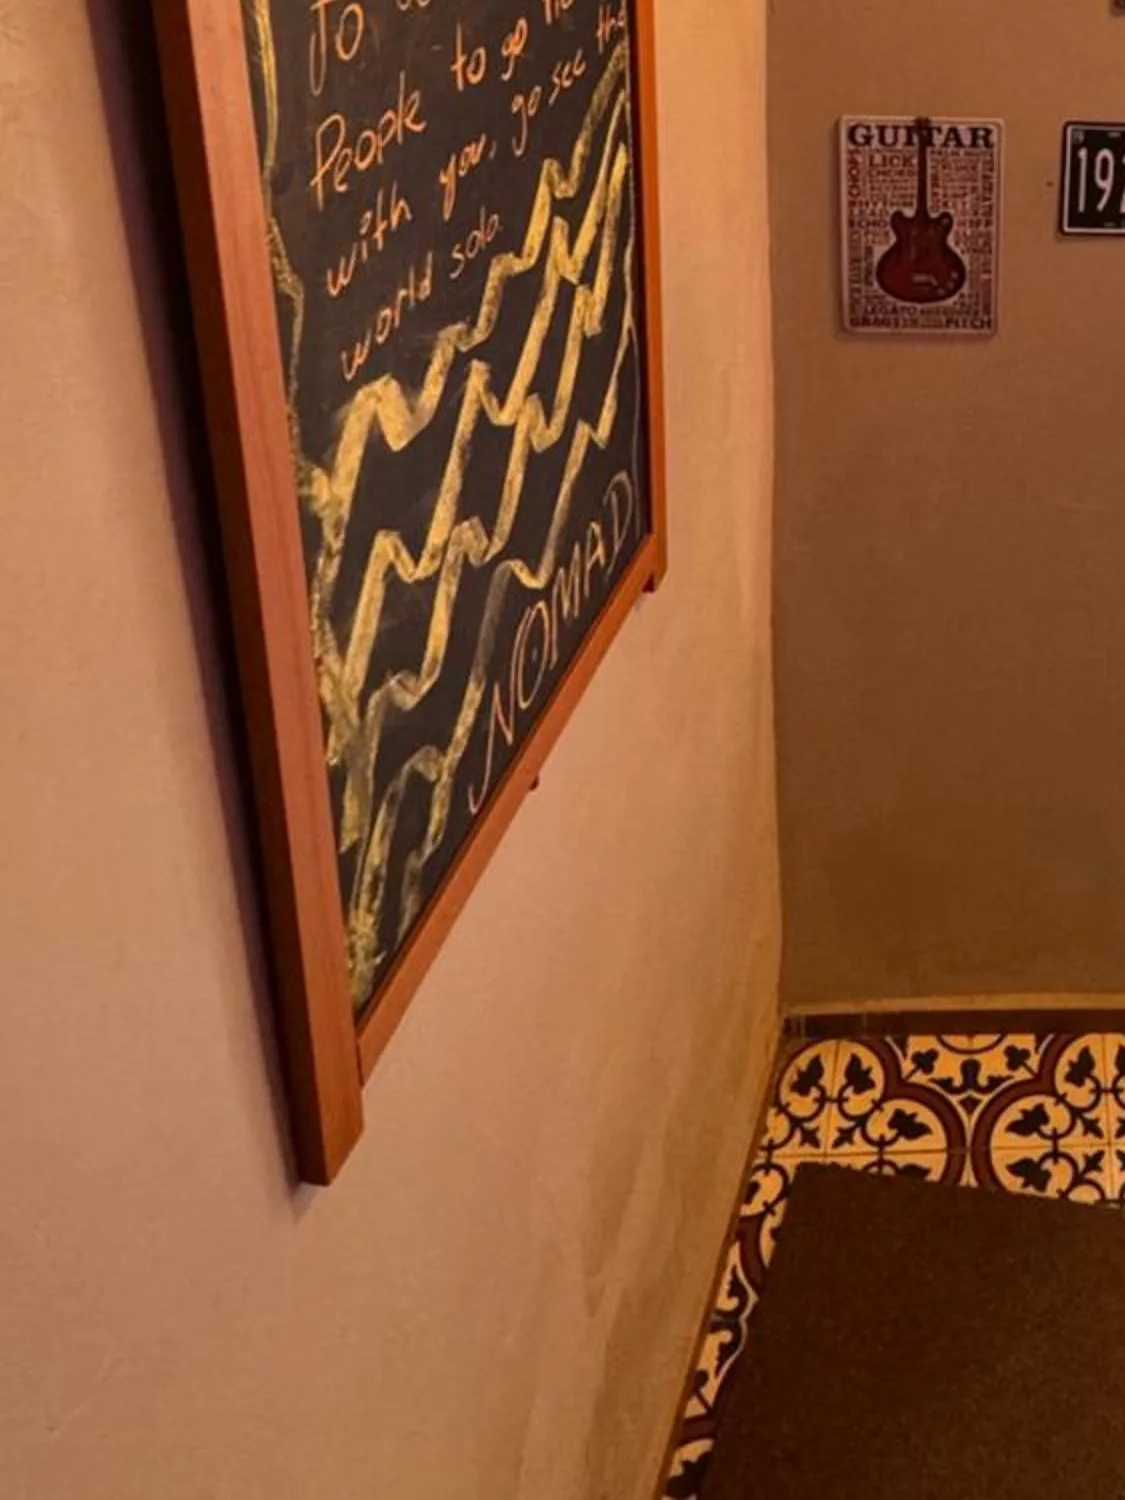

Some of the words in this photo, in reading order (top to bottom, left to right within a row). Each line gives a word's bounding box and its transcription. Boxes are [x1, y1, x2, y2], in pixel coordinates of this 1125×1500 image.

[310, 71, 427, 213] People
[451, 23, 487, 93] to
[326, 180, 414, 298] with
[511, 86, 543, 158] go
[547, 48, 588, 106] see
[848, 123, 995, 150] GUITAR
[340, 250, 434, 382] world
[468, 469, 633, 815] NOMAD
